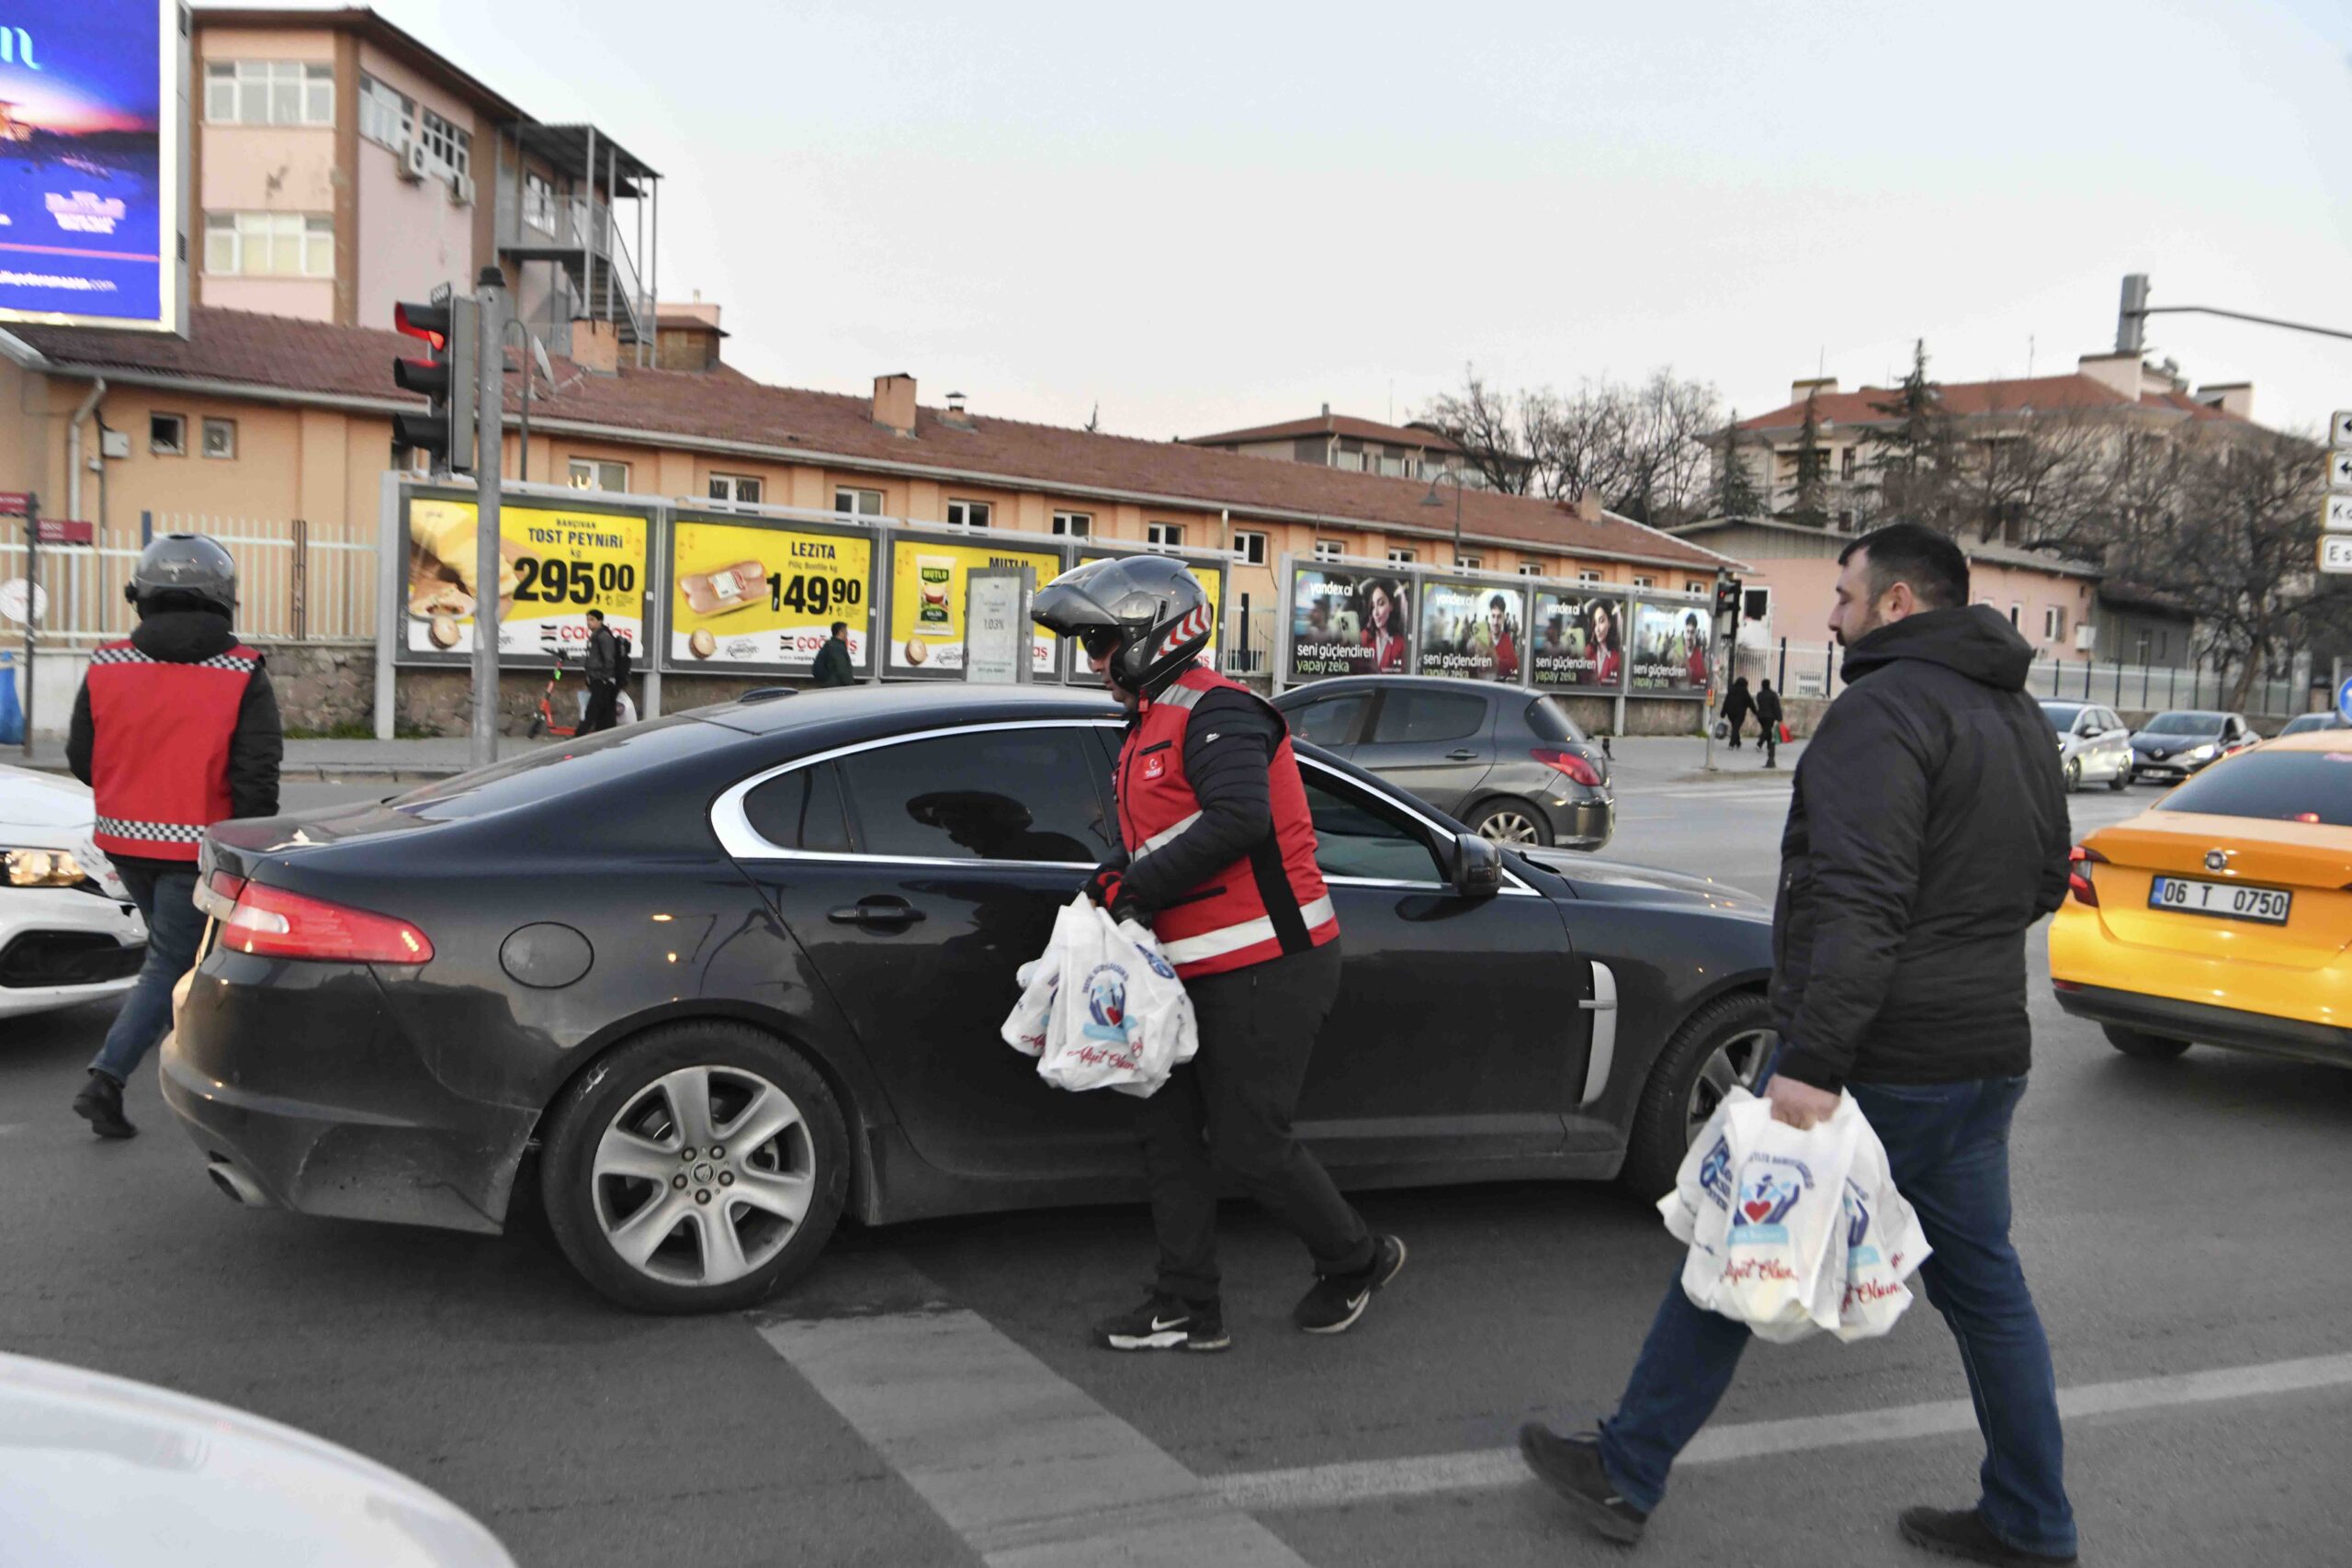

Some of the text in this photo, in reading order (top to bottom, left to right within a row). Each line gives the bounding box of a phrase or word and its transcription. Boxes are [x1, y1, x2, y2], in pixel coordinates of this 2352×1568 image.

[528, 527, 562, 544] TOST
[922, 568, 948, 580] MUTLU
[1309, 581, 1343, 595] yandex
[1546, 603, 1573, 615] yandex
[1297, 642, 1375, 660] seni güçlendiren
[1296, 660, 1350, 674] yapay zeka
[1423, 652, 1492, 669] seni güçlendiren
[1536, 655, 1597, 671] seni güçlendiren
[1634, 662, 1647, 675] seni
[1535, 670, 1577, 683] yapay zeka
[2164, 882, 2285, 916] 06 T 0750
